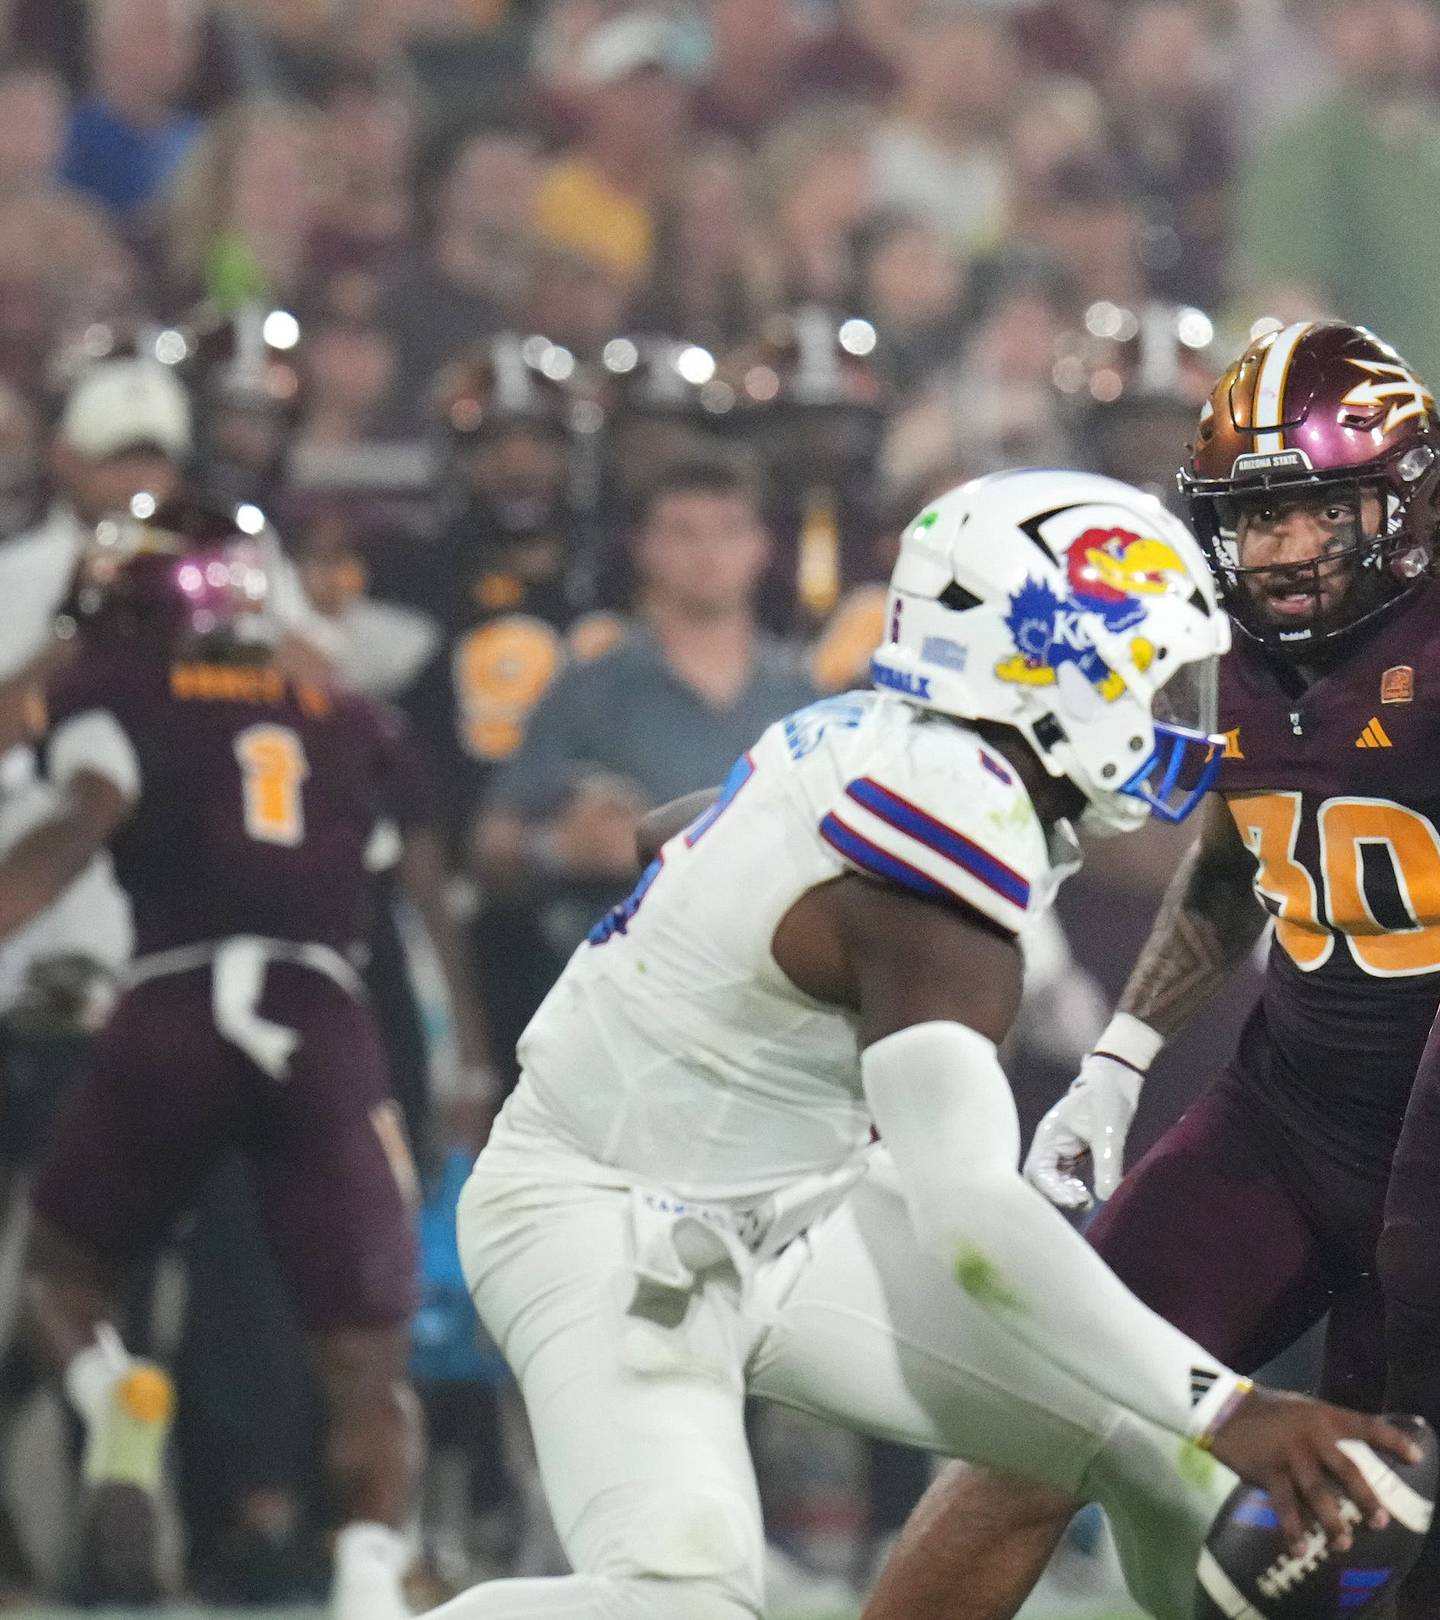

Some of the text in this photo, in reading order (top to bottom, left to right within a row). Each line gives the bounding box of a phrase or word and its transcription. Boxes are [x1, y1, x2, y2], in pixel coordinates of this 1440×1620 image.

[1239, 454, 1299, 471] ARIZONA STATE
[232, 721, 313, 848] 1
